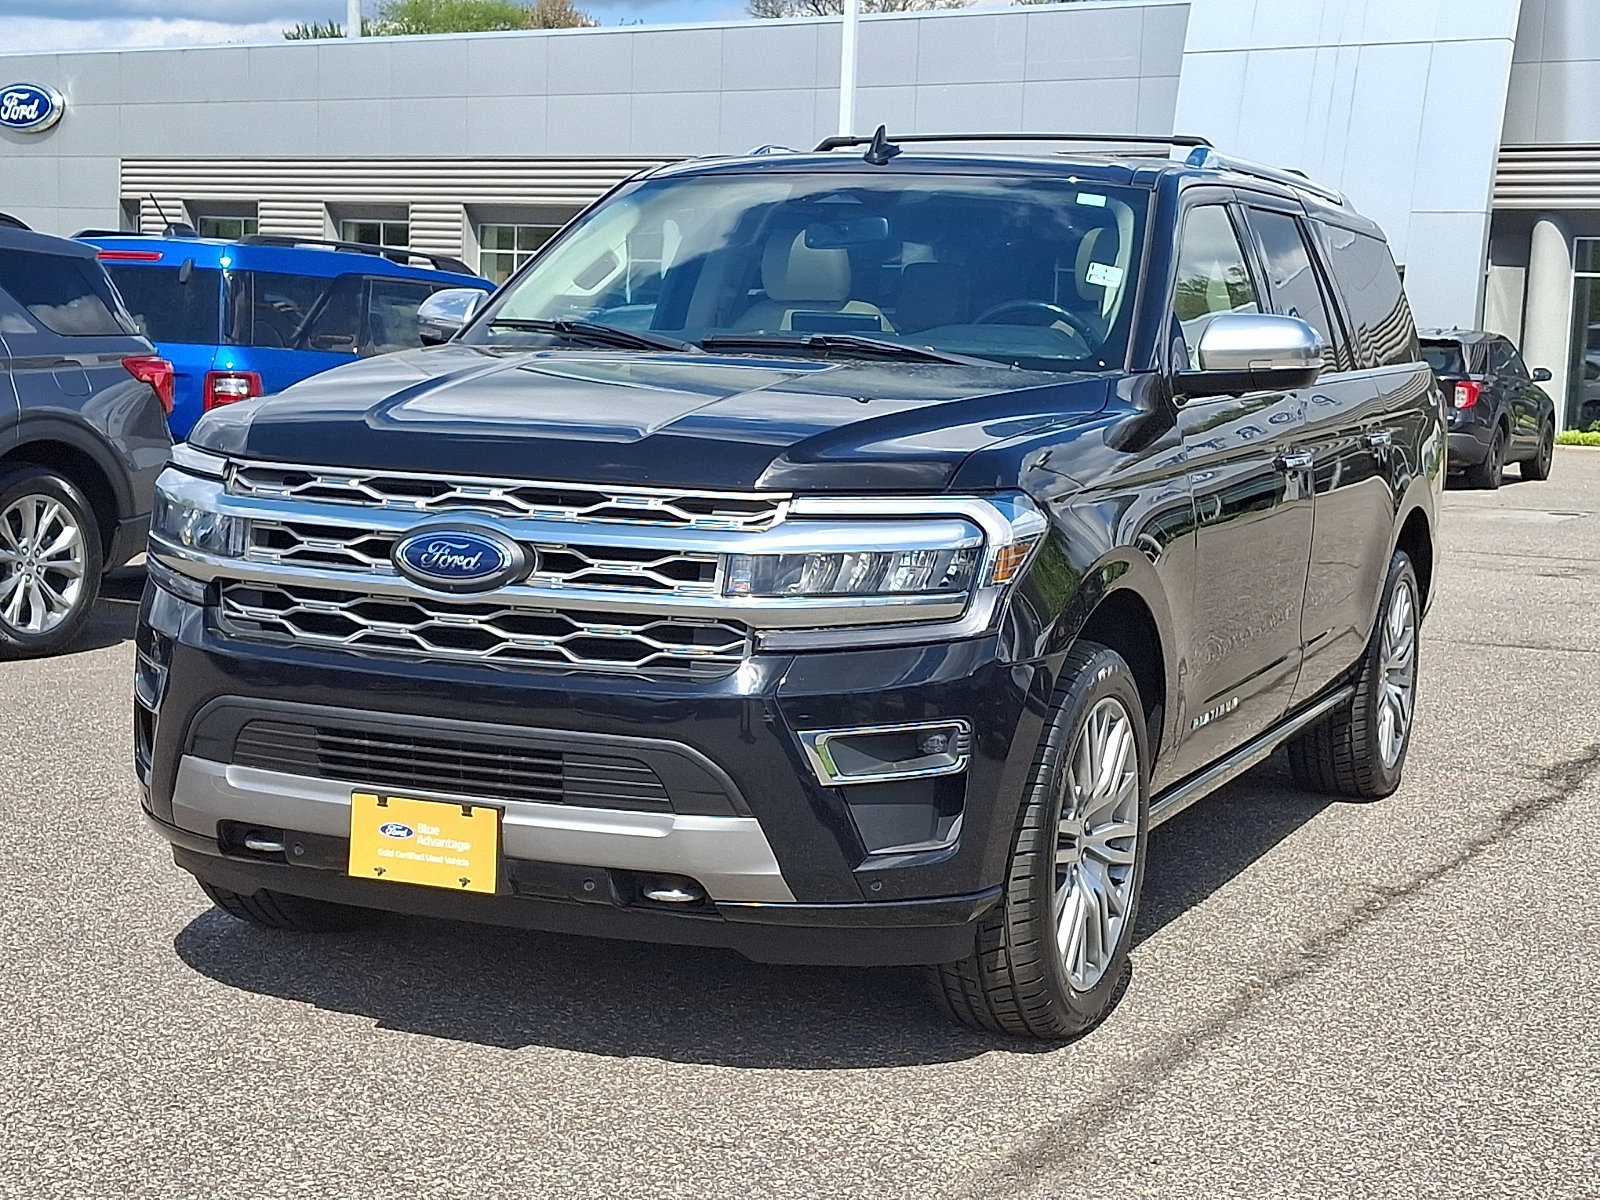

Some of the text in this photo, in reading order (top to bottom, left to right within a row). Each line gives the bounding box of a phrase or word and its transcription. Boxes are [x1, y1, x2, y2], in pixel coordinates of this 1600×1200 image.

[1, 92, 39, 120] Ford
[420, 540, 483, 571] Ford
[385, 823, 408, 837] Ford
[417, 823, 440, 835] Blue
[417, 835, 471, 852] Advantage
[395, 850, 425, 861] Certified
[425, 854, 444, 863] Used
[445, 856, 469, 867] Vehicle
